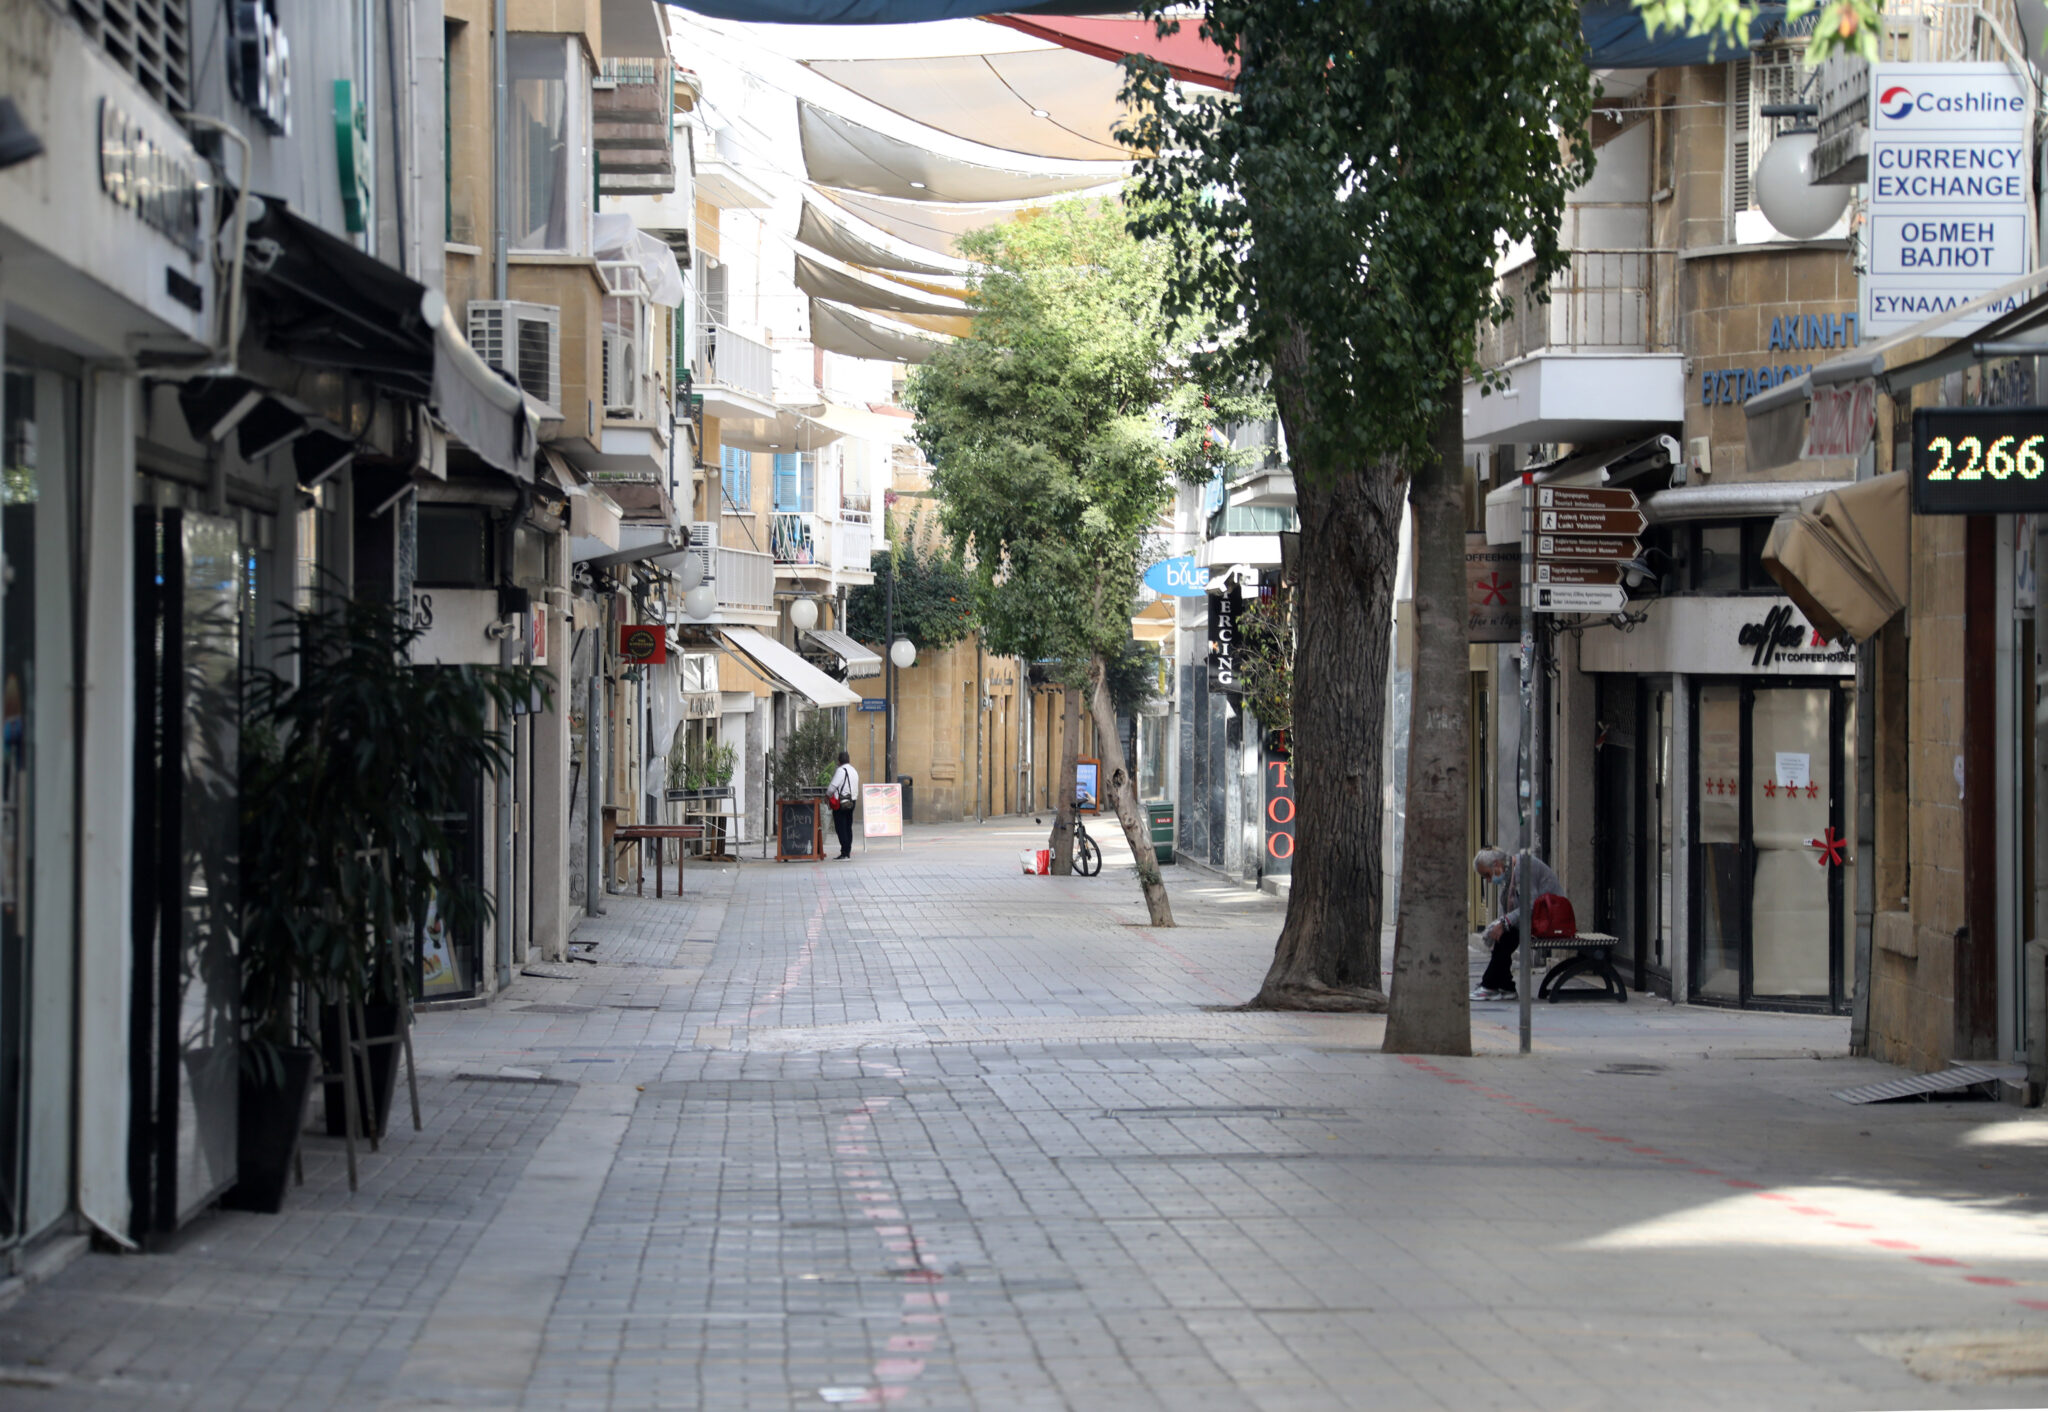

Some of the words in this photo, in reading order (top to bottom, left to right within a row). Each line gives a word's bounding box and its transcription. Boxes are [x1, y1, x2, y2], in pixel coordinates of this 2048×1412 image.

[1916, 91, 2025, 112] Cashline
[1878, 148, 2022, 169] CURRENCY
[1878, 176, 2020, 196] EXCHANGE
[1901, 222, 1994, 242] ОБМЕН
[1901, 247, 1995, 267] ВАЛЮТ
[1875, 296, 2017, 313] ΣΥΝΑΛΛΜΑ
[1928, 435, 2045, 480] 2266
[1775, 652, 1787, 662] BY
